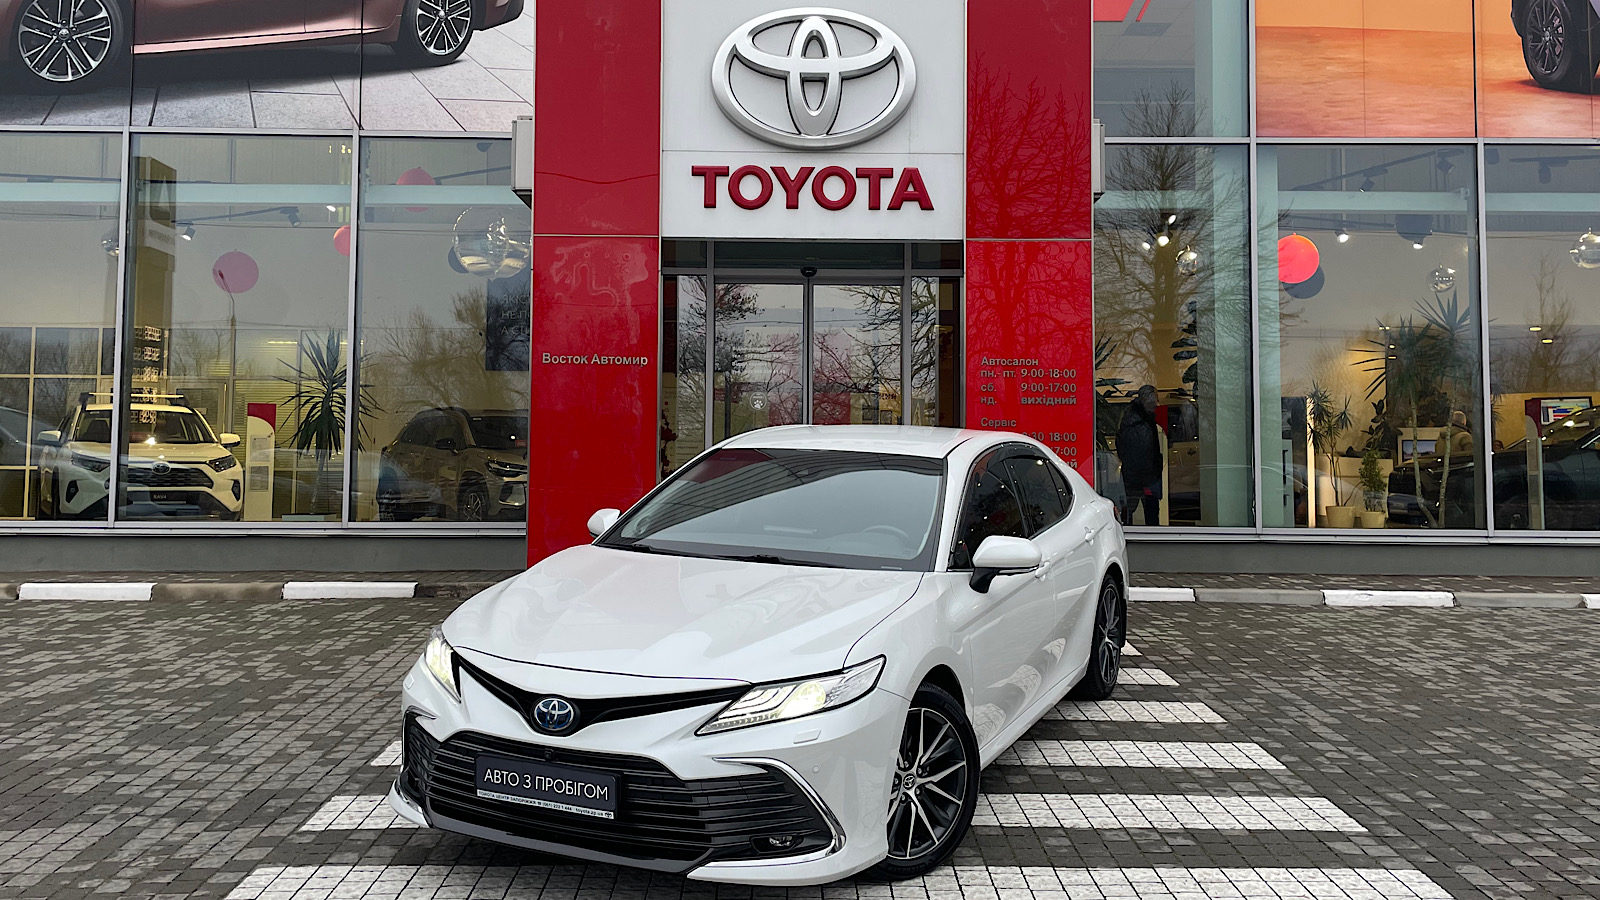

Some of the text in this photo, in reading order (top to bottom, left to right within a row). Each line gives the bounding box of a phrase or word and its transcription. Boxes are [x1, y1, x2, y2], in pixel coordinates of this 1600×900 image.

[691, 164, 935, 211] TOYOTA
[501, 294, 530, 304] ЯКІС
[542, 352, 648, 367] Восток Автомир
[980, 356, 1039, 366] Автосалон
[980, 383, 1077, 393] сб. 9:00-17:00
[980, 395, 1077, 406] нд. вихідний
[980, 417, 1017, 429] Сервіс
[1051, 447, 1077, 457] 7:00
[483, 768, 608, 801] АВТО З ПРОБІГОМ
